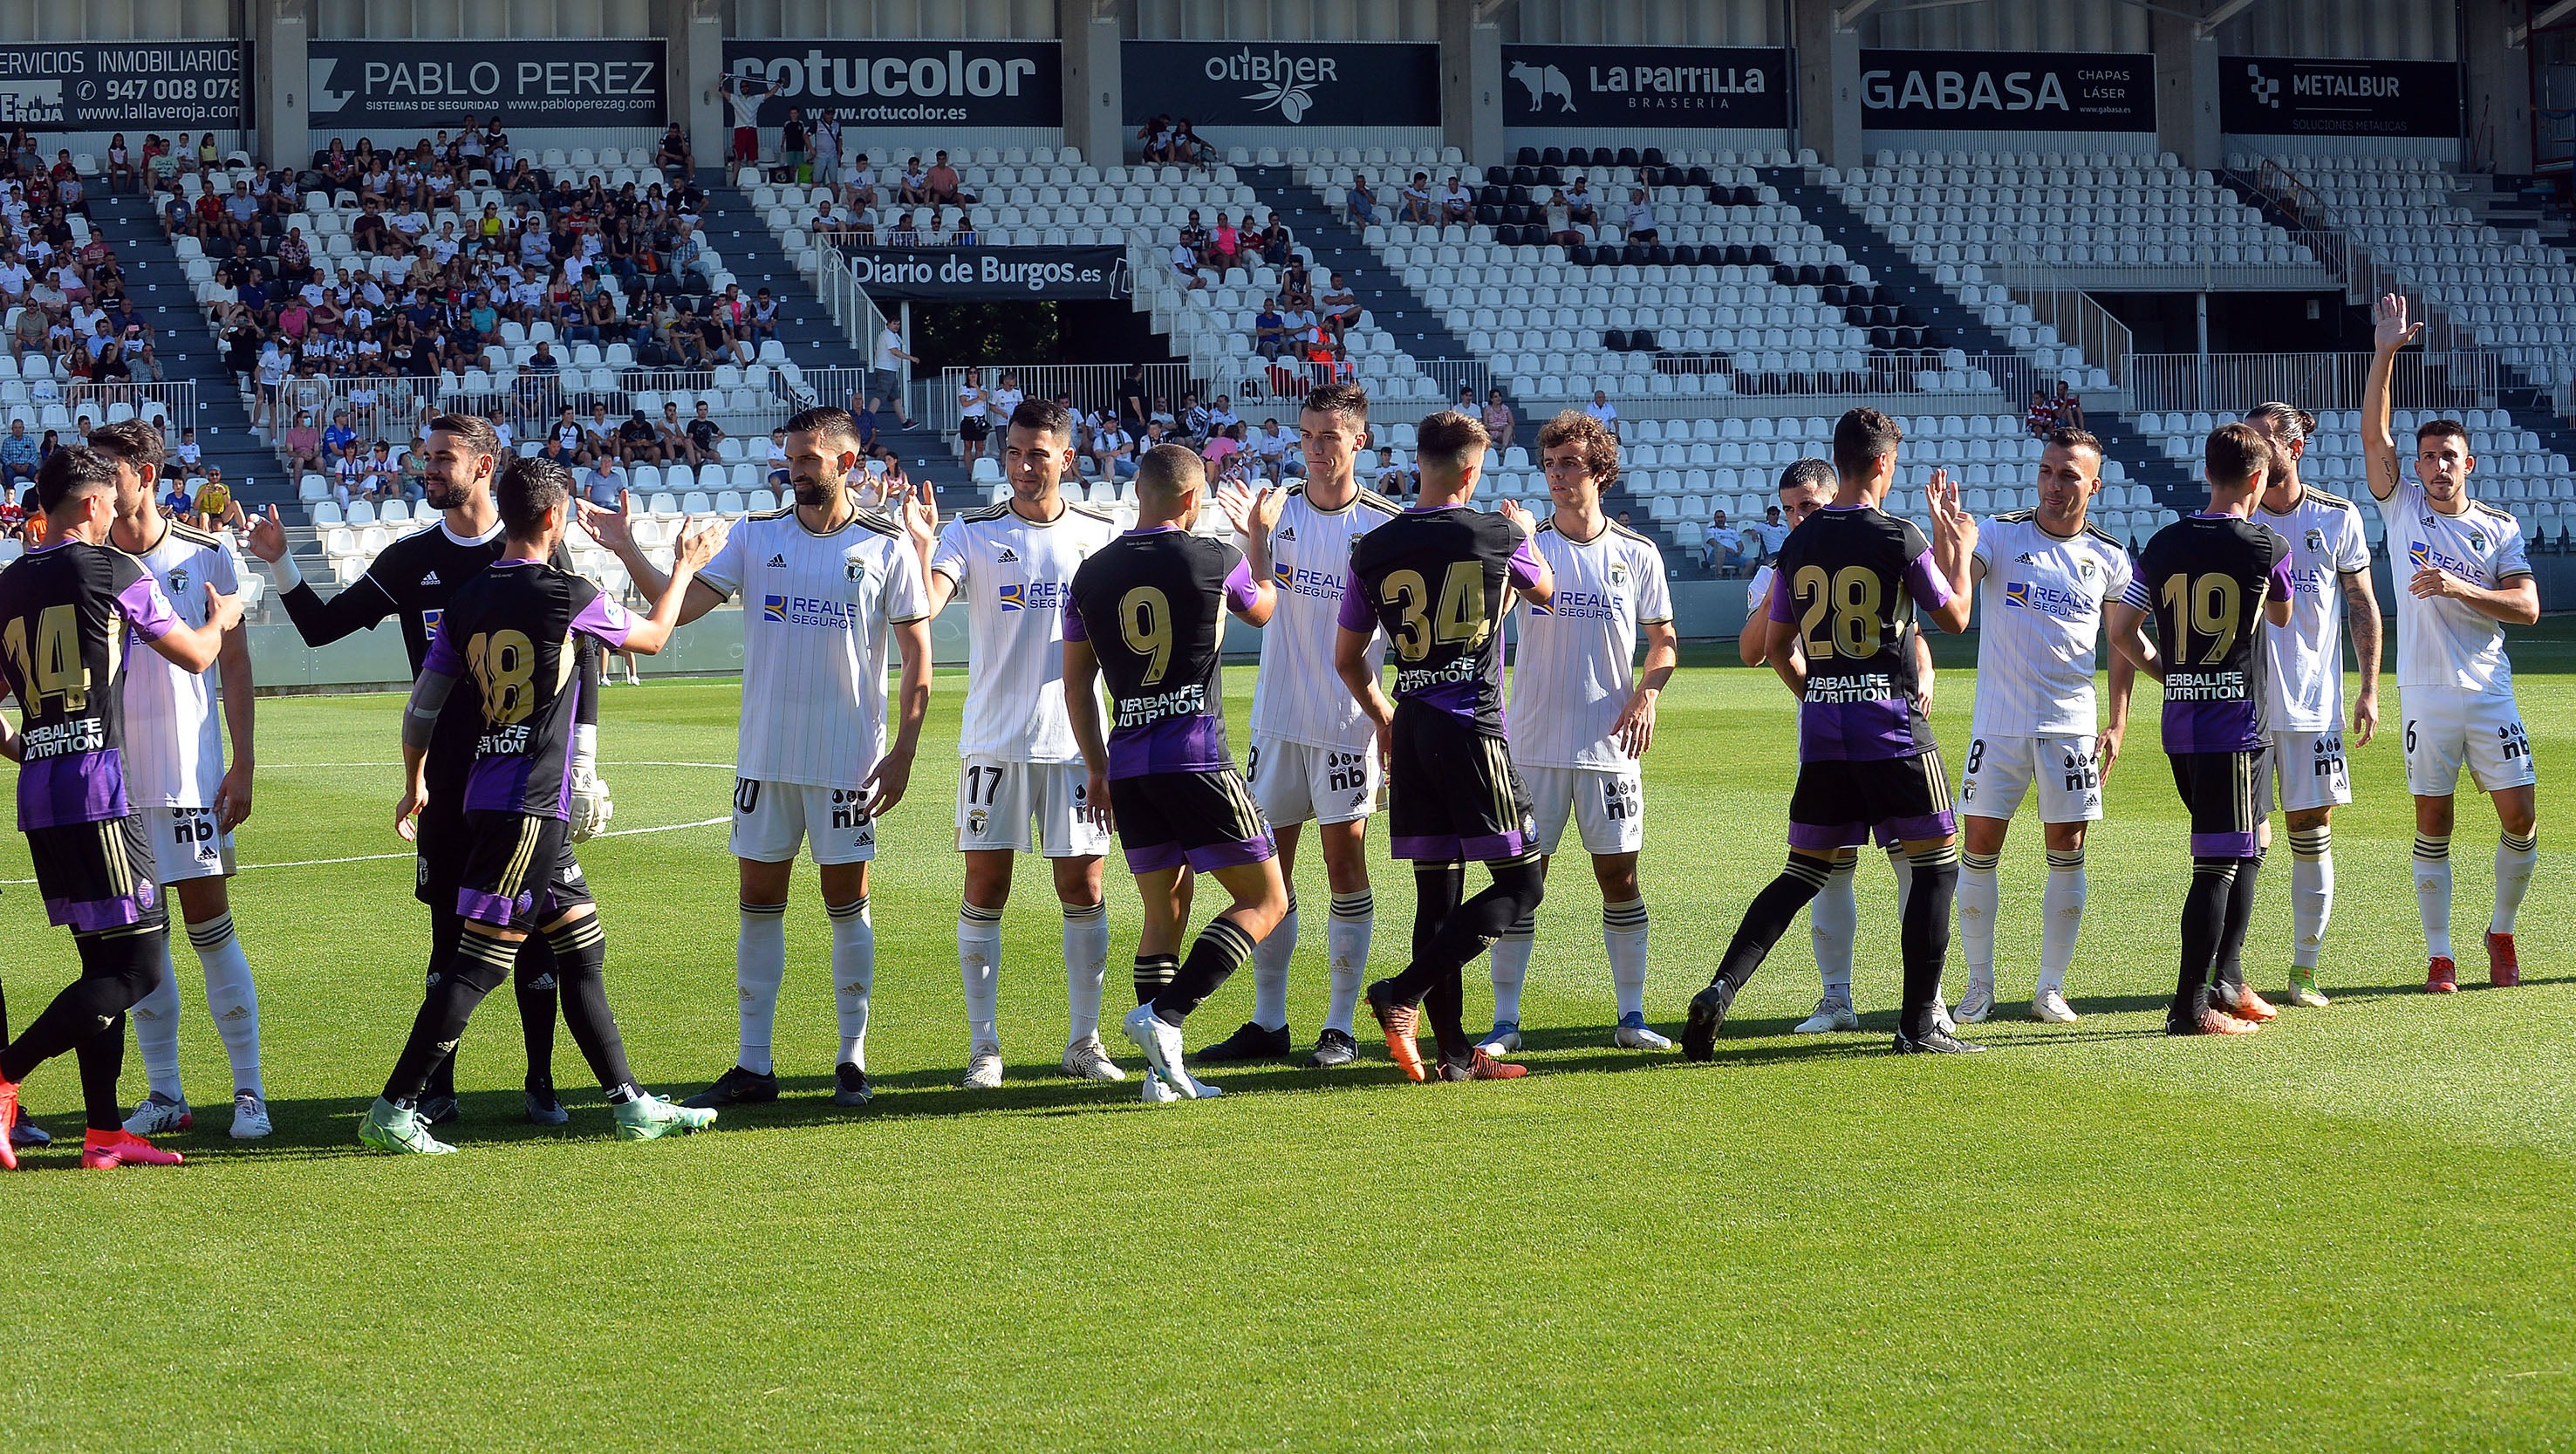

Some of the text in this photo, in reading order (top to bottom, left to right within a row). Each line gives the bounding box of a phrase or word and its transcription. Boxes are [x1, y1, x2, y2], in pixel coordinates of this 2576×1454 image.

[365, 61, 655, 95] PABLO PEREZ
[733, 50, 1036, 97] rotucolor
[1590, 66, 1629, 92] La
[2078, 70, 2130, 81] CHAPAS
[2293, 74, 2400, 97] METALBUR
[106, 79, 239, 100] 947 008 078
[1861, 70, 2069, 111] GABASA
[2084, 85, 2126, 99] LÁSER
[366, 100, 500, 111] SISTEMAS DE SEGURIDAD
[507, 98, 656, 112] www.pabloperezag.com
[1629, 96, 1729, 108] BRASERÍA
[2080, 106, 2131, 114] www.gabasa.es
[2292, 119, 2354, 131] SOLUCIONES
[851, 255, 933, 283] Diario
[940, 255, 974, 283] de
[2433, 551, 2484, 580] REALE
[1029, 583, 1070, 597] REA
[1295, 568, 1346, 590] REAL
[793, 597, 858, 618] REALE
[1380, 559, 1491, 663] 34
[1560, 591, 1623, 611] REALE
[1794, 564, 1882, 660] 28
[791, 614, 855, 630] SEGUROS
[1558, 607, 1621, 622] SEGUROS
[2161, 572, 2241, 666] 19
[1118, 585, 1172, 686] 9
[2, 604, 92, 719] 14
[466, 629, 536, 729] 18
[2165, 672, 2245, 686] HERBALIFE
[2164, 685, 2245, 701] NUTRITION
[2406, 720, 2417, 754] 6
[1967, 739, 1987, 775] 8
[2314, 753, 2344, 776] nb
[967, 765, 1004, 807] 17
[1330, 766, 1366, 792] nb
[2065, 768, 2098, 792] nb
[832, 803, 870, 829] nb
[1607, 796, 1637, 821] nb
[174, 819, 214, 844] nb
